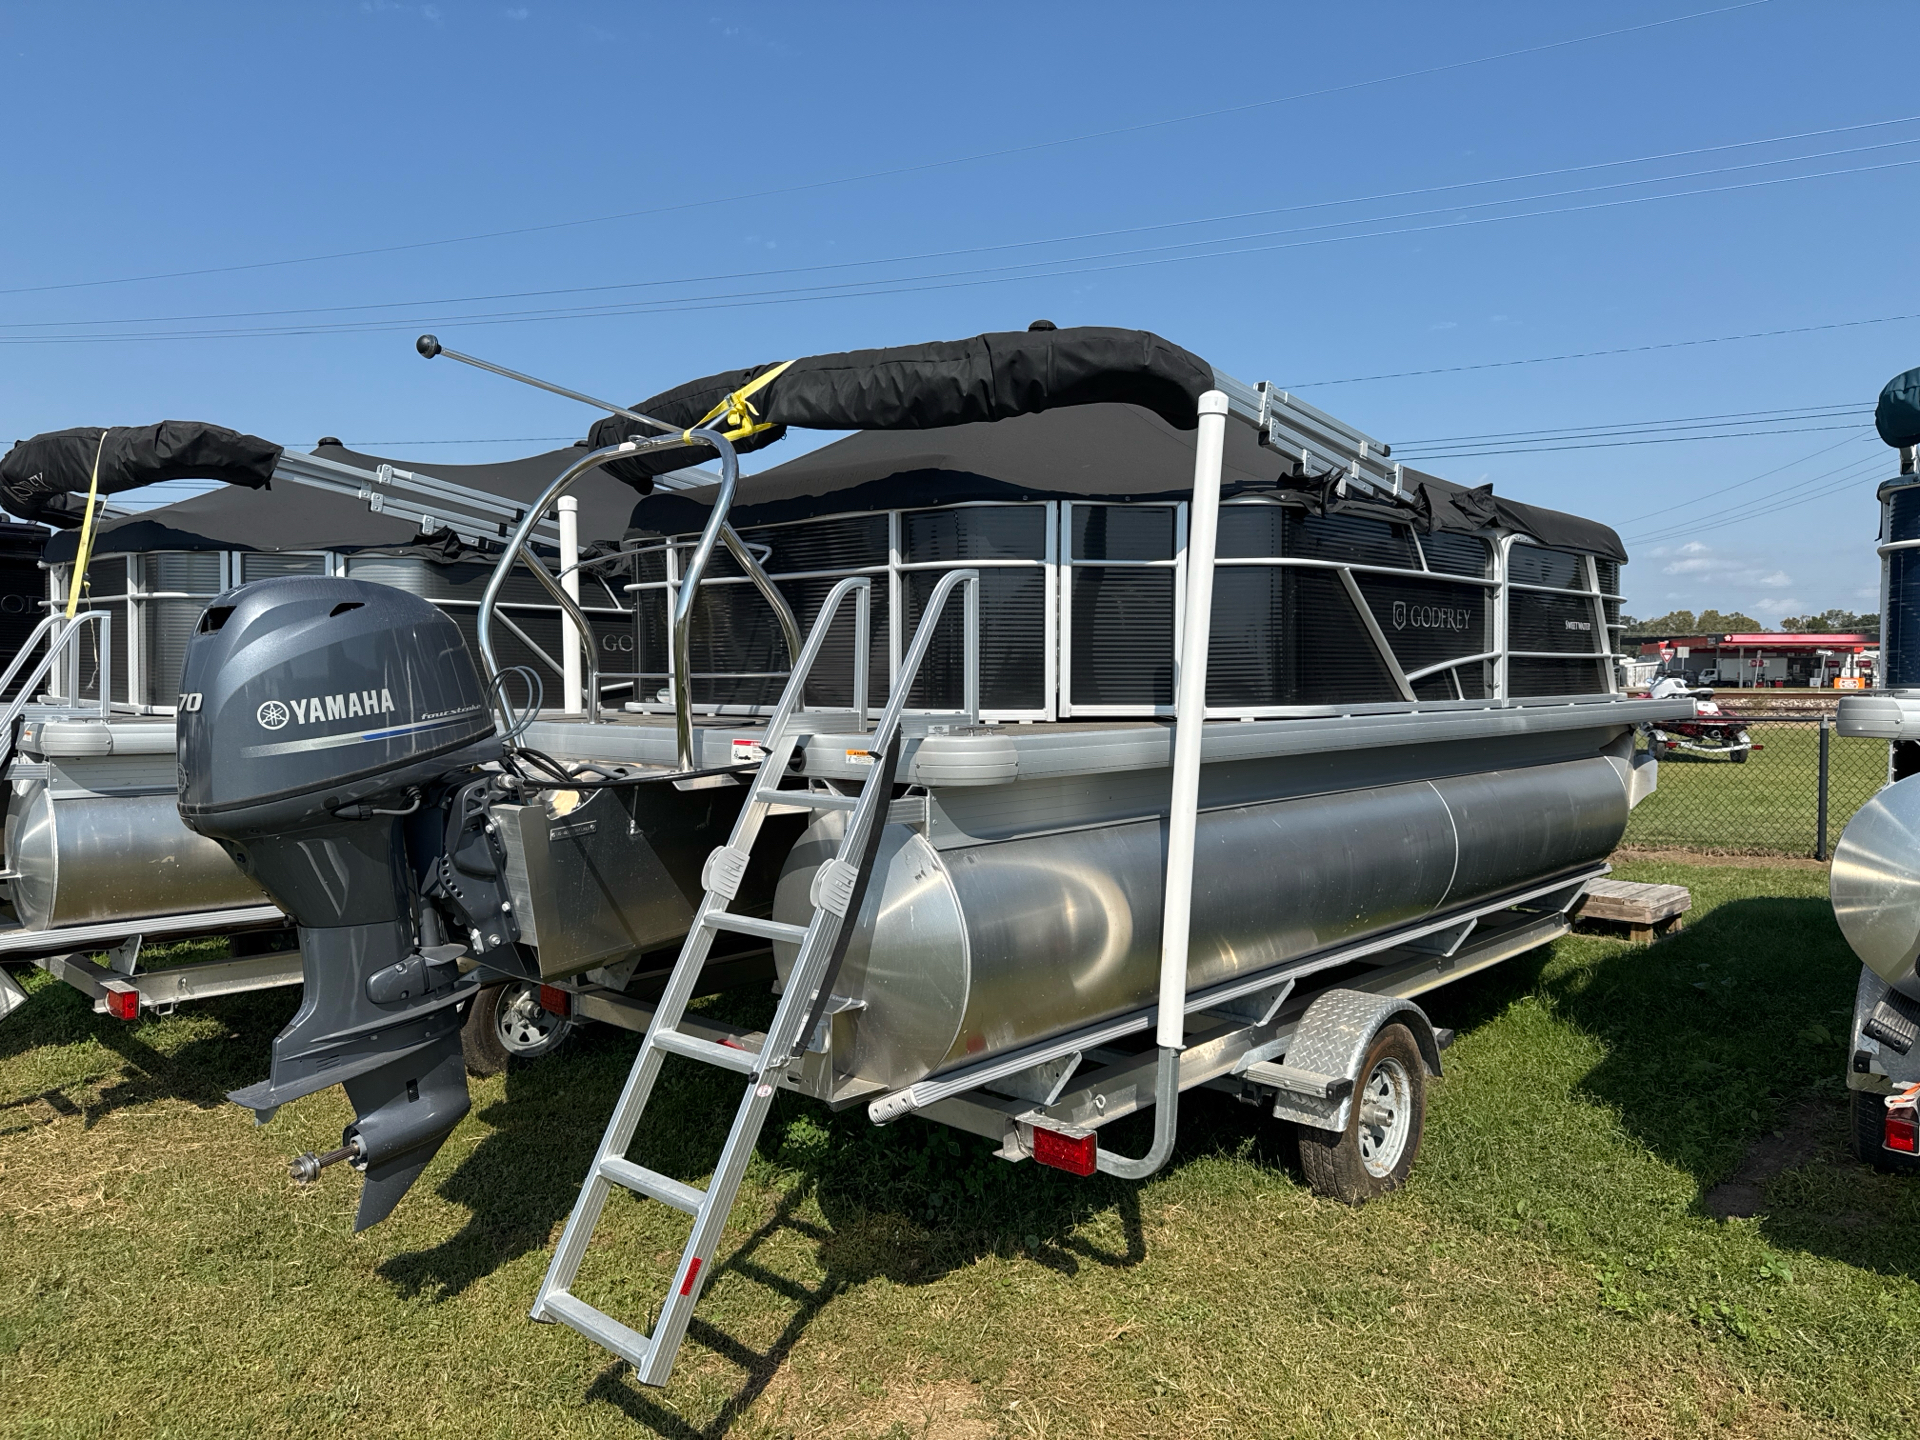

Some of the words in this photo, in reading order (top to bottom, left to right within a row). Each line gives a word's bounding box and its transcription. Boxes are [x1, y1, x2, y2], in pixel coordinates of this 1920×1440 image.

[1410, 605, 1472, 633] GODFREY
[179, 692, 203, 712] 70
[289, 688, 396, 725] YAMAHA
